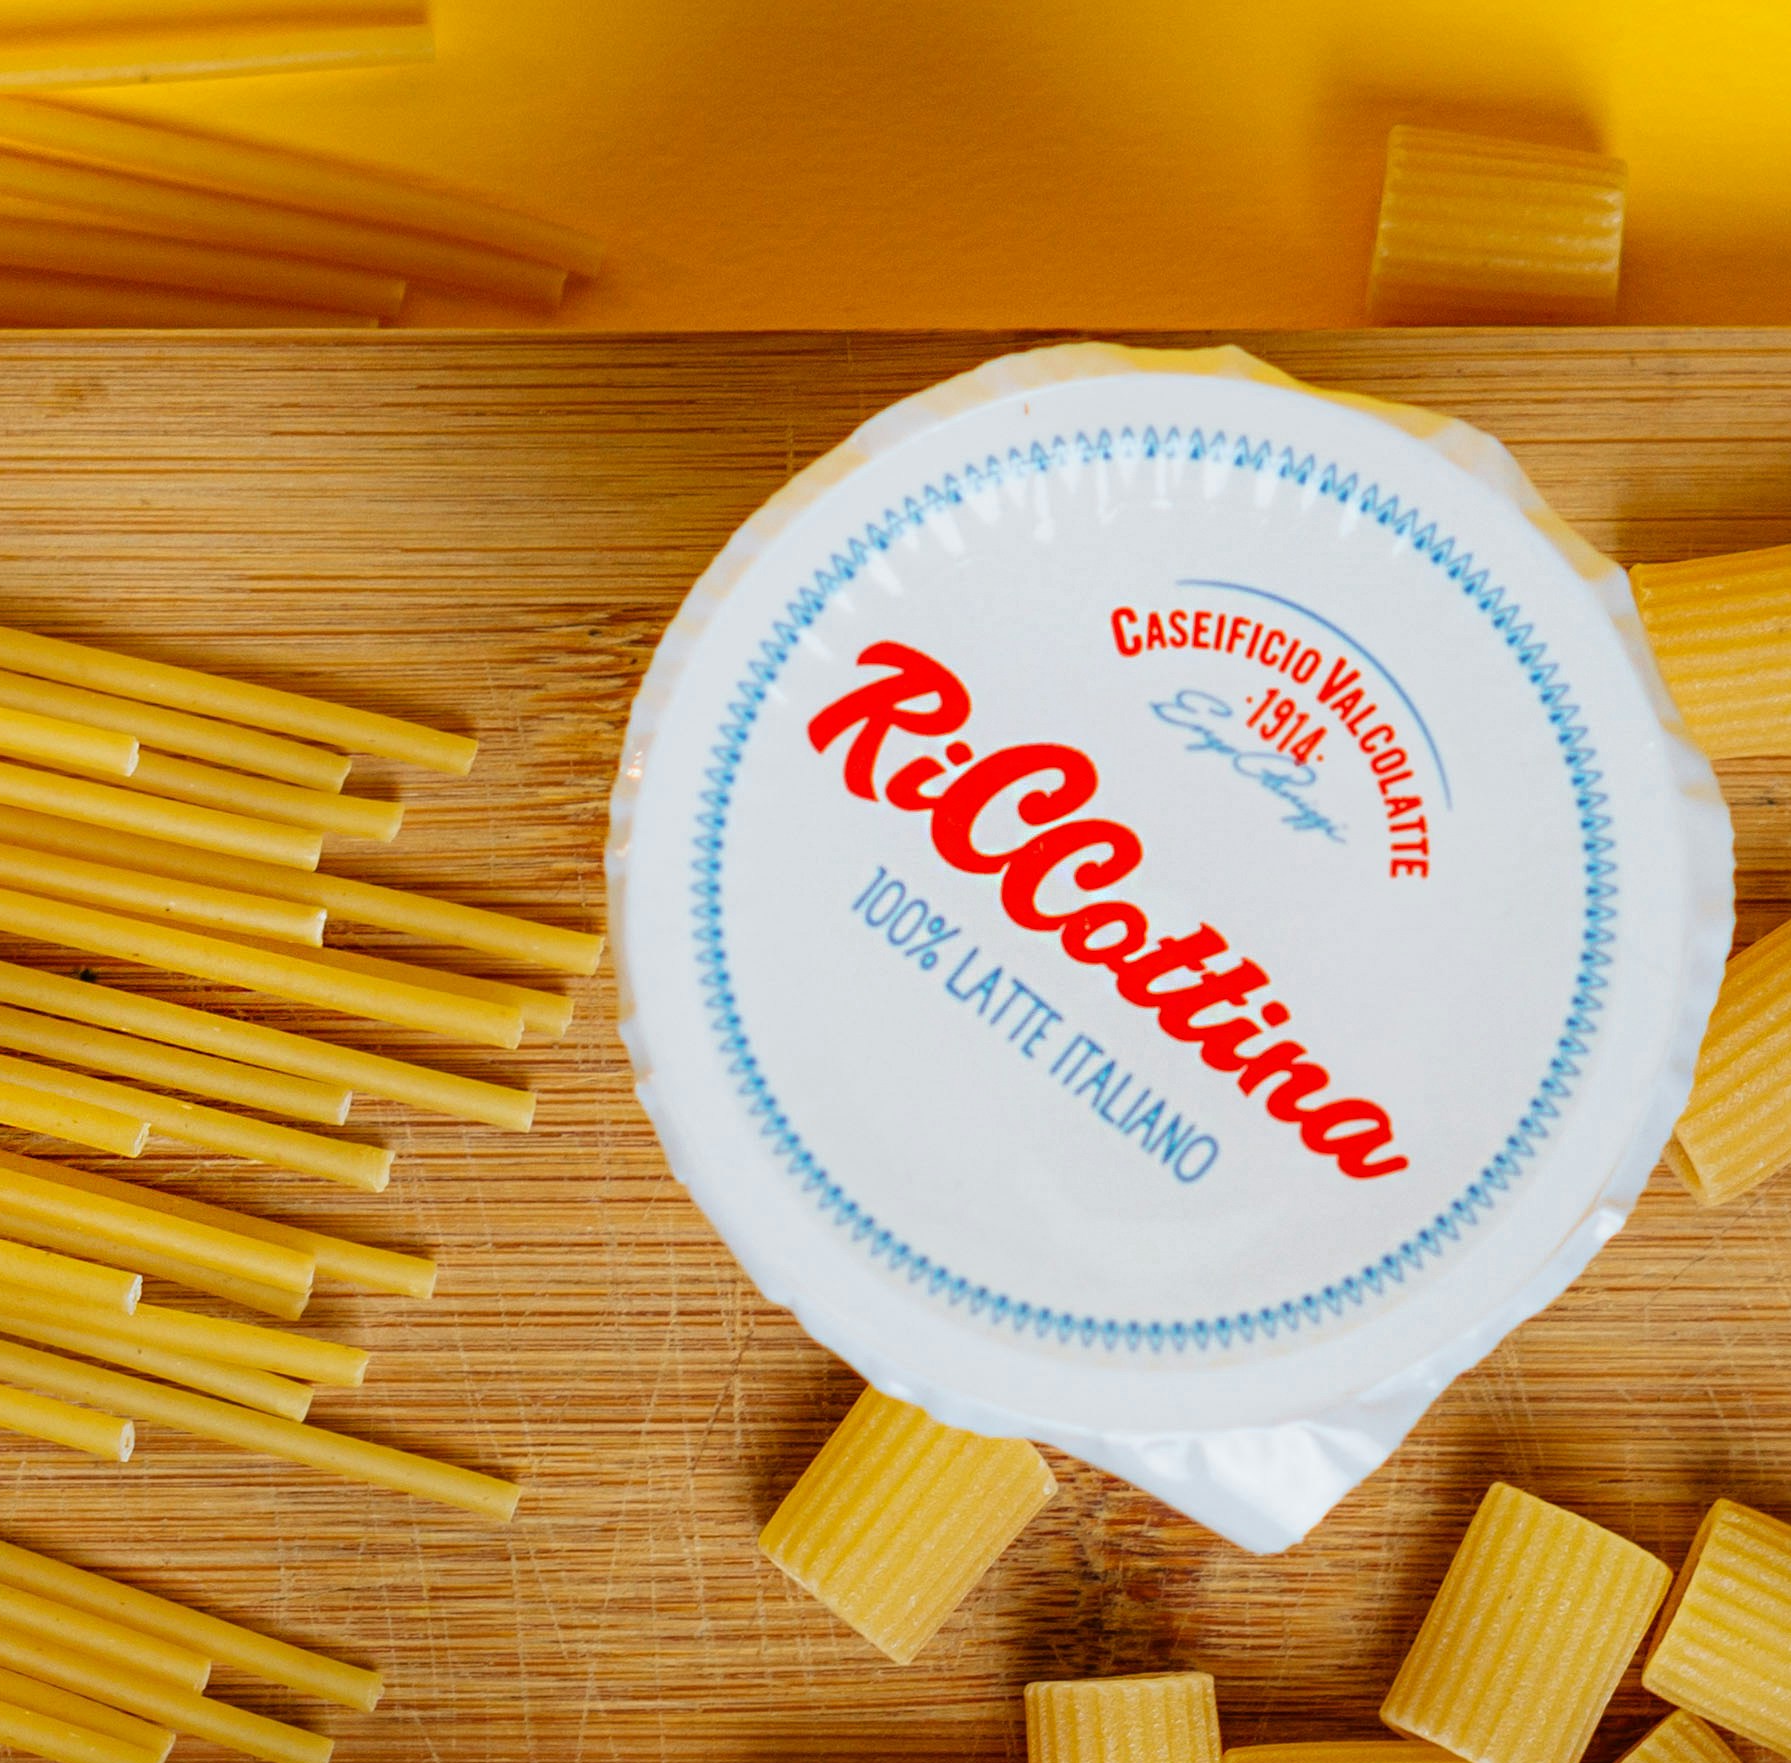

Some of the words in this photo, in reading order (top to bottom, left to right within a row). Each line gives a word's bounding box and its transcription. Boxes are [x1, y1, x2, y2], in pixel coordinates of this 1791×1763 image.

[1110, 606, 1323, 685] CASEIFICIO
[1316, 657, 1429, 879] VALCOLATTE
[805, 639, 1409, 1181] RiCCottina
[852, 864, 962, 971] 100%
[944, 946, 1065, 1060] LATTE
[1048, 1032, 1219, 1184] ITALIANO
